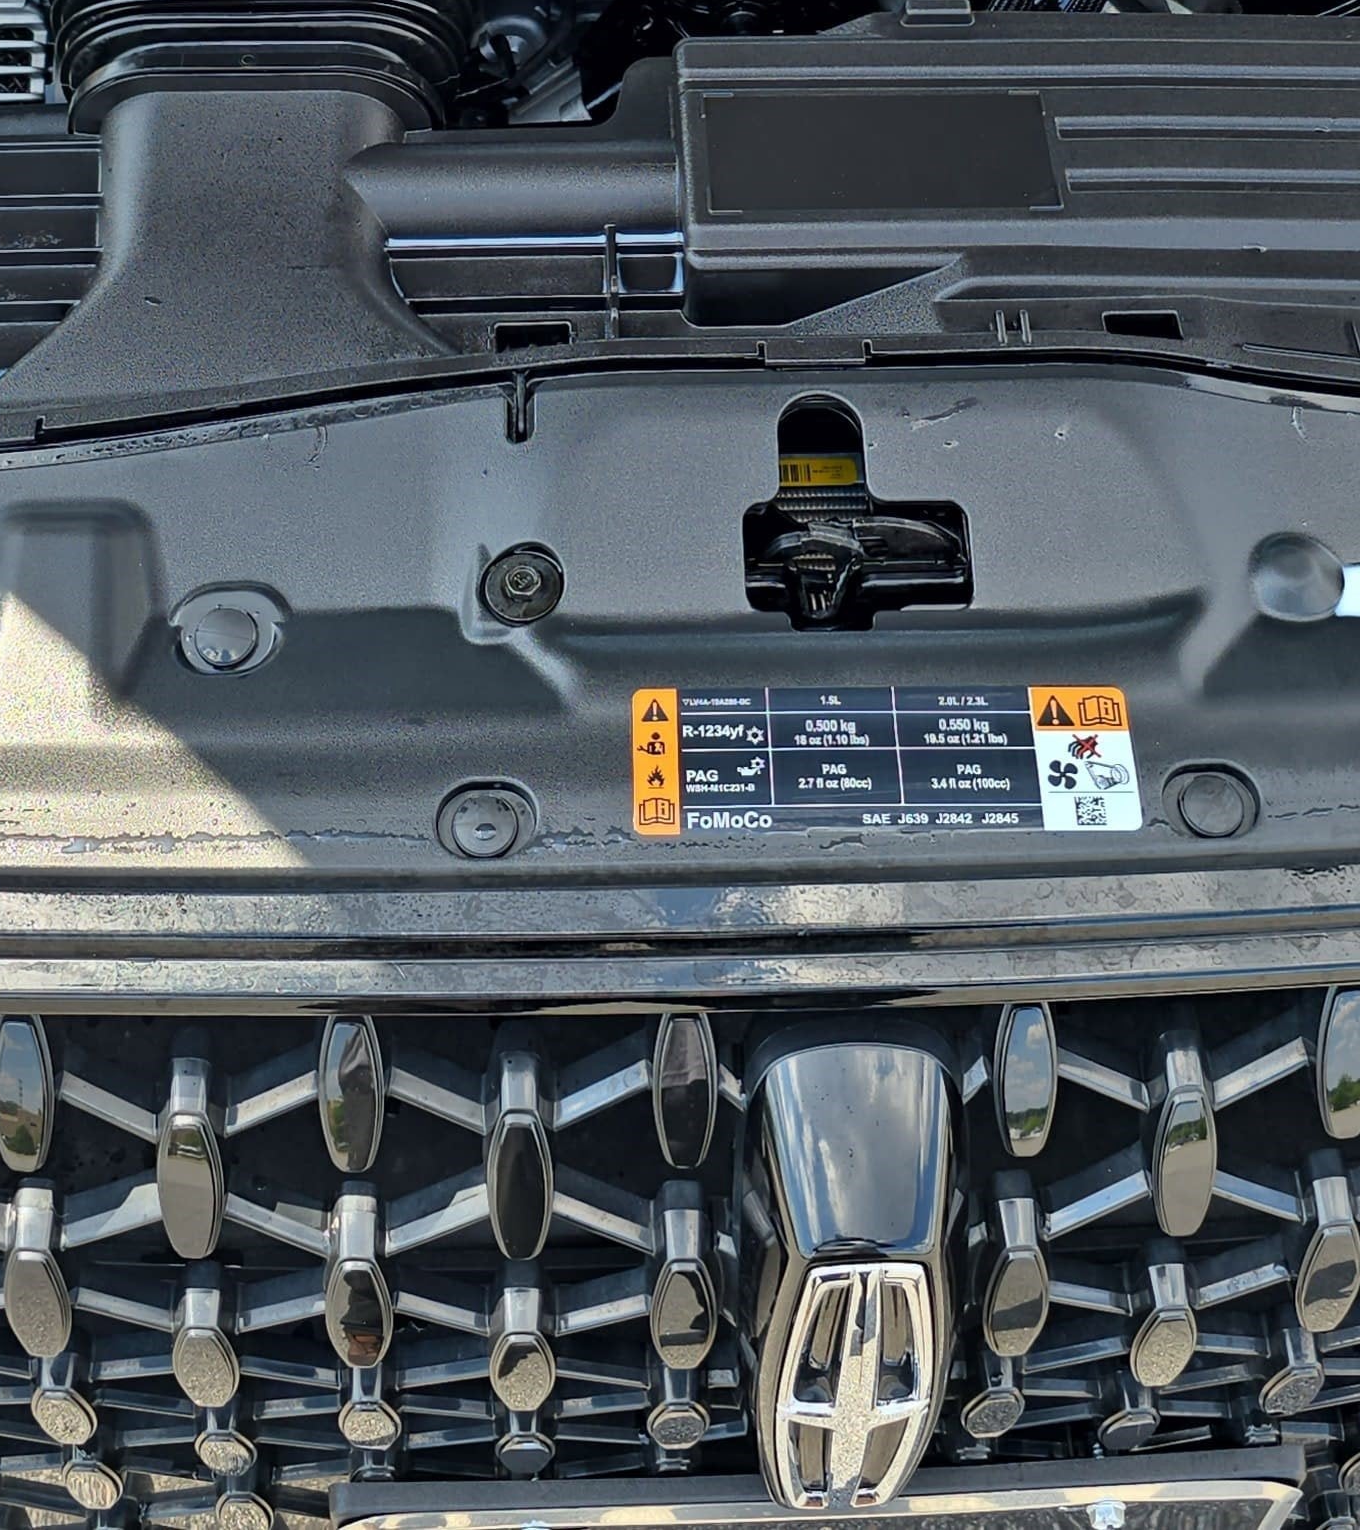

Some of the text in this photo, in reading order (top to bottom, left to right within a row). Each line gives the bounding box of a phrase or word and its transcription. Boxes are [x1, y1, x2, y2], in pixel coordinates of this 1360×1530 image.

[819, 695, 842, 705] 1.5L
[937, 696, 960, 706] 2.0L
[966, 696, 989, 706] 2.3L
[805, 719, 857, 734] 0.500 kg
[938, 717, 990, 733] 0.550 kg
[682, 724, 745, 740] R-1234yf
[808, 736, 822, 745] oz
[823, 734, 848, 746] (1.10
[849, 734, 870, 746] lbs)
[923, 733, 1008, 746] 19.5 oz (1.21 lbs)
[822, 764, 847, 775] PAG
[957, 764, 982, 775] PAG
[685, 770, 719, 782] PAG
[798, 777, 872, 790] 2.7 fl oz (80cc)
[930, 777, 1011, 790] 3.4 fl oz (100cc)
[687, 812, 772, 829] FoMoCo
[862, 813, 1019, 824] SAE J639 J2842 J2845
